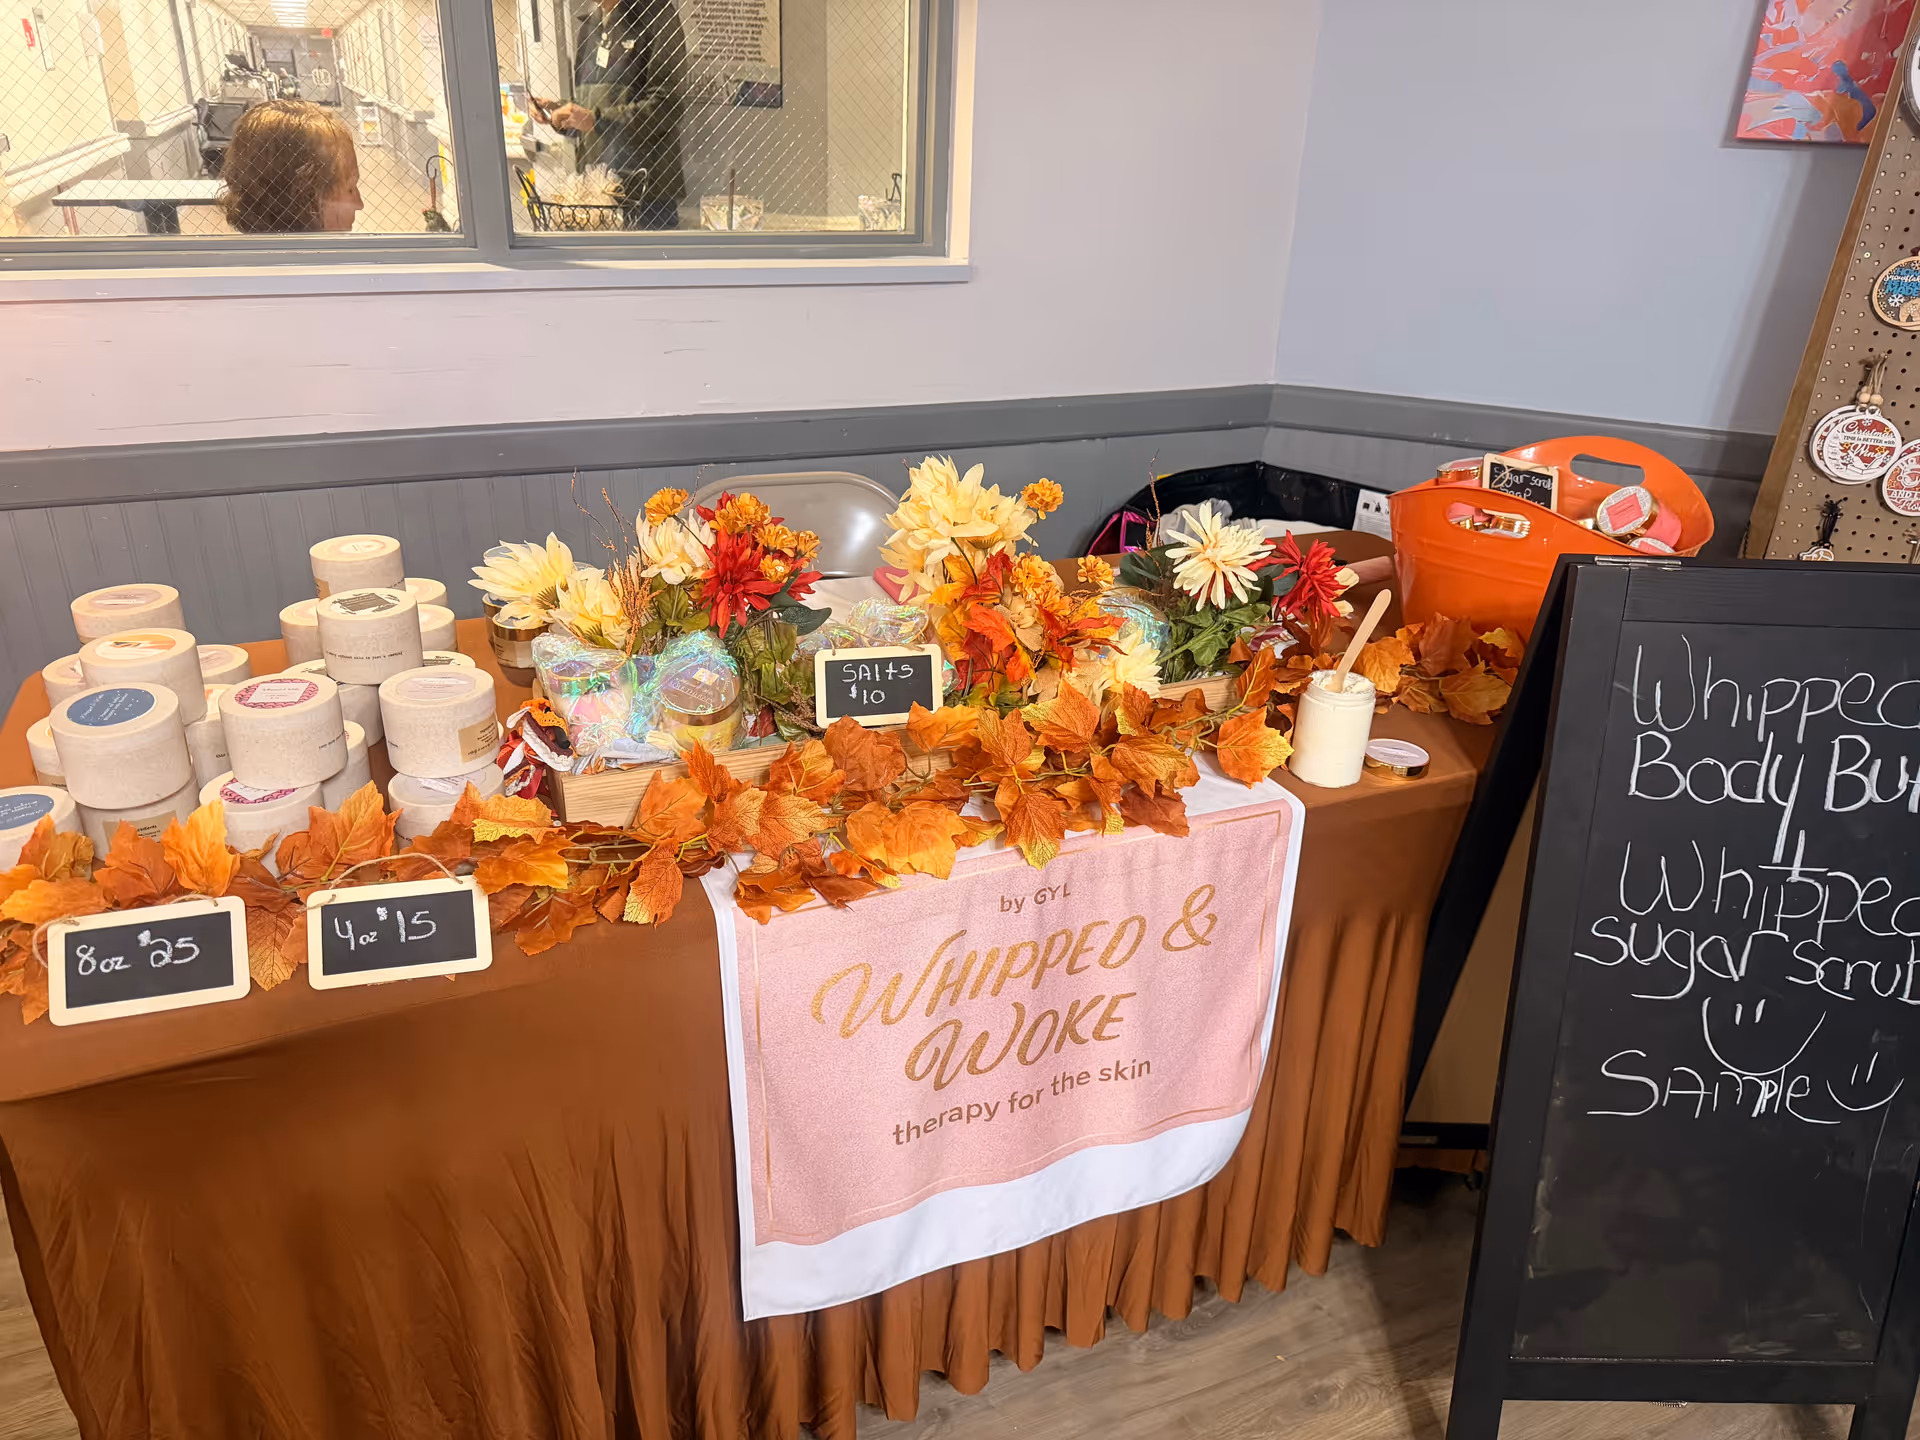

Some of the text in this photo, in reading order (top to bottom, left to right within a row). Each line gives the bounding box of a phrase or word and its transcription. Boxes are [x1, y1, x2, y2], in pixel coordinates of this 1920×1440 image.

[849, 683, 886, 705] $10
[1628, 731, 1804, 864] Body
[376, 906, 438, 943] $15
[1000, 882, 1072, 914] by GYL
[137, 929, 200, 969] $25
[810, 883, 1218, 1040] WHIPPED &
[904, 991, 1137, 1092] WOKE
[891, 1058, 1153, 1147] therapy for the skin
